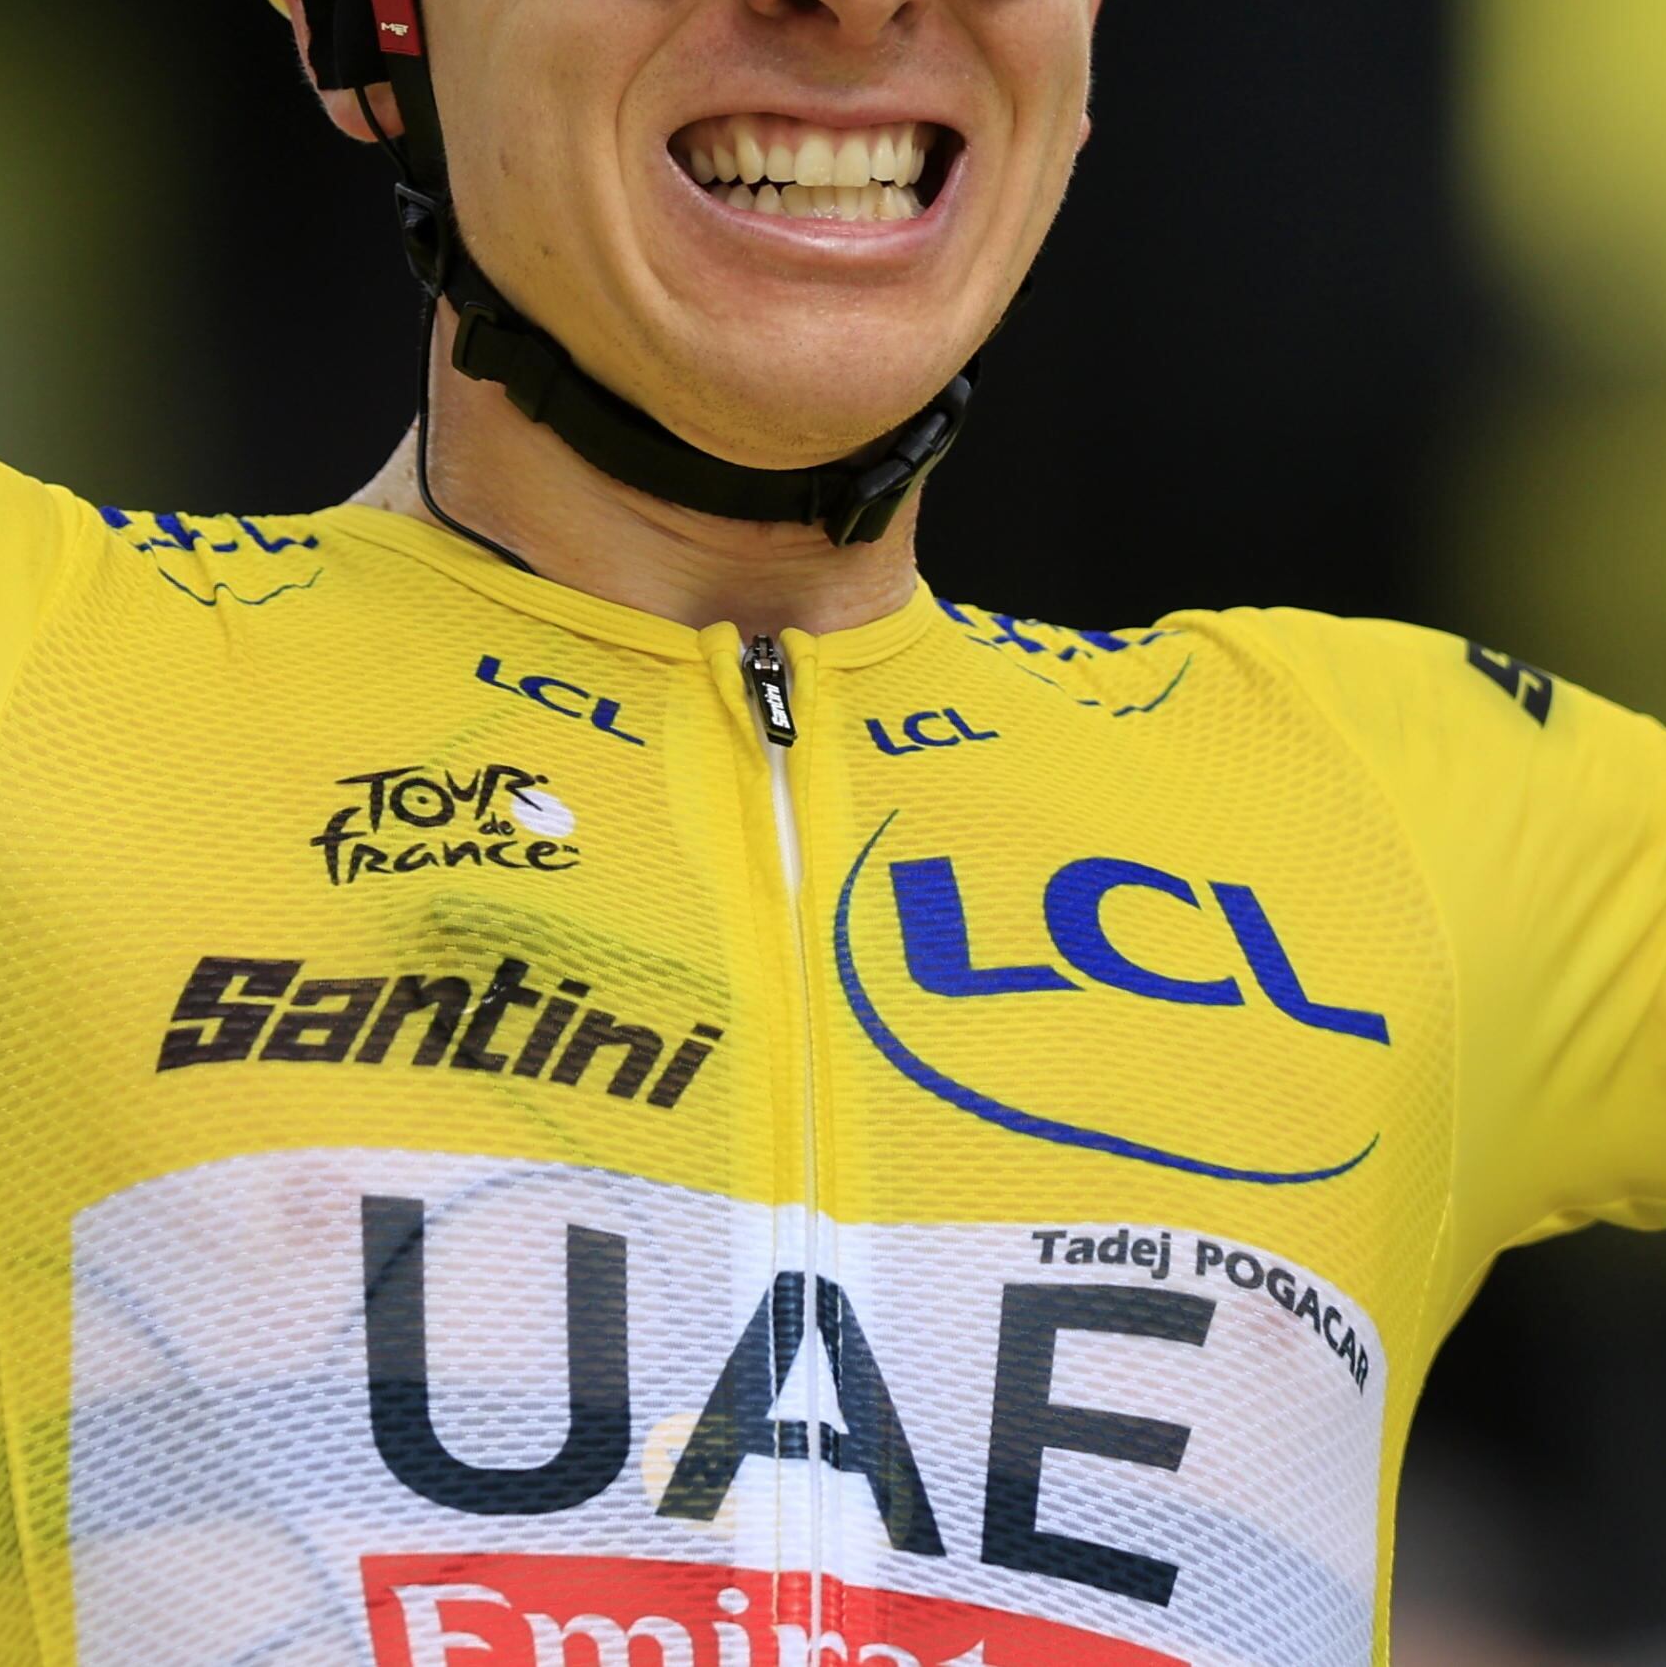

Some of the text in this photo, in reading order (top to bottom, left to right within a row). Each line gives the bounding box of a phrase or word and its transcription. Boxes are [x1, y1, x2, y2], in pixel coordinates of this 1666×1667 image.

[380, 22, 409, 36] MET
[474, 654, 645, 747] LCL
[864, 707, 1000, 756] LCL
[477, 811, 516, 836] de
[888, 856, 1391, 1047] LCL
[155, 954, 725, 1109] Santini
[1031, 1229, 1369, 1396] Tadej POGACAR
[360, 1195, 1218, 1608] UAE
